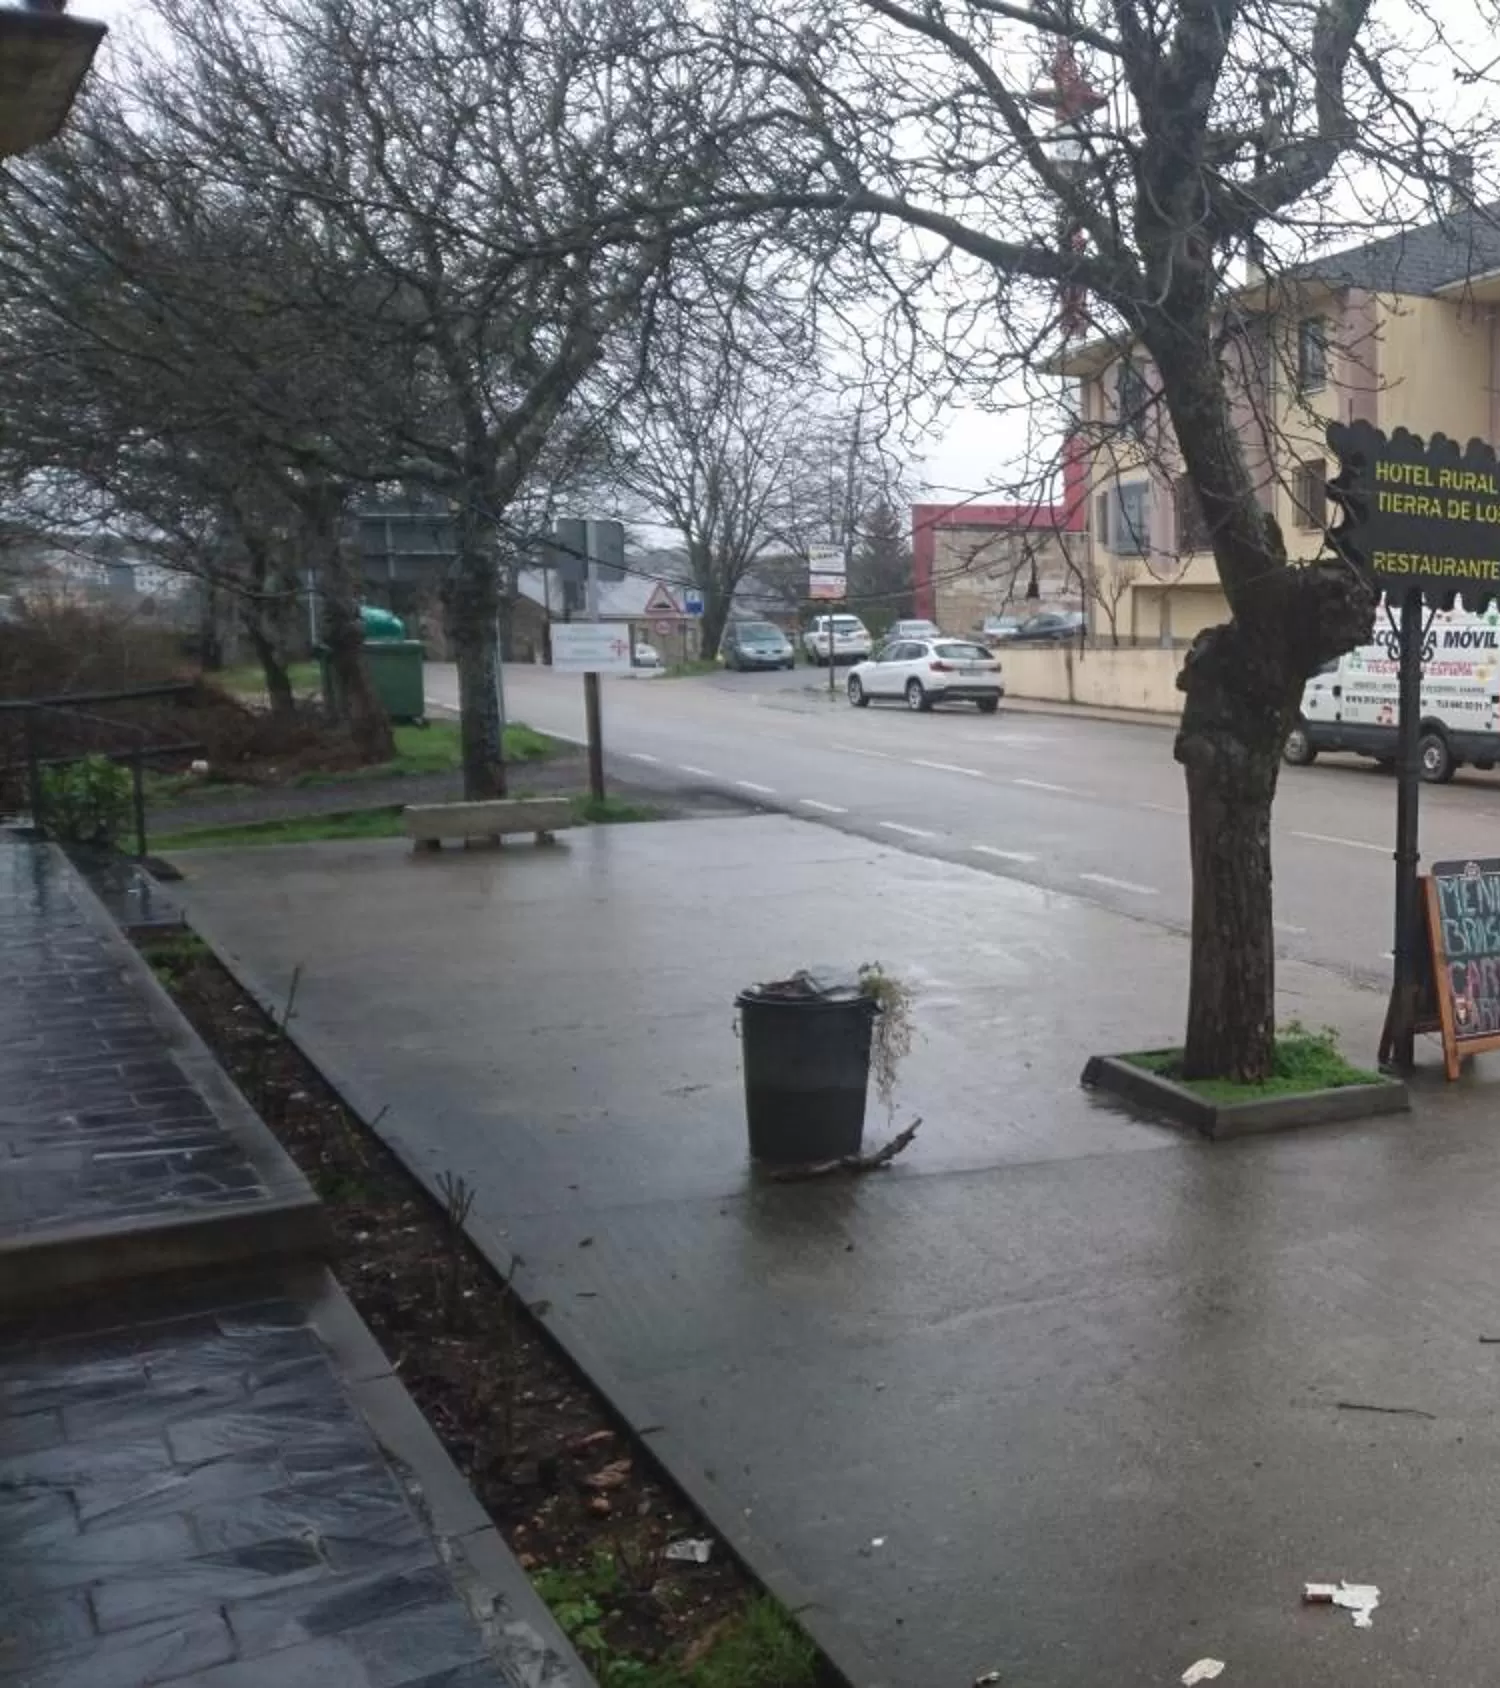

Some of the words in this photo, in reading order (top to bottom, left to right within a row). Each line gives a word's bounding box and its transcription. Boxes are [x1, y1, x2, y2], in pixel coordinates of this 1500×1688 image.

[1375, 461, 1434, 487] HOTEL
[1439, 467, 1499, 495] RURAL
[1377, 491, 1443, 518] TIERRA
[1447, 499, 1471, 521] DE
[1443, 626, 1499, 649] MÓVIL
